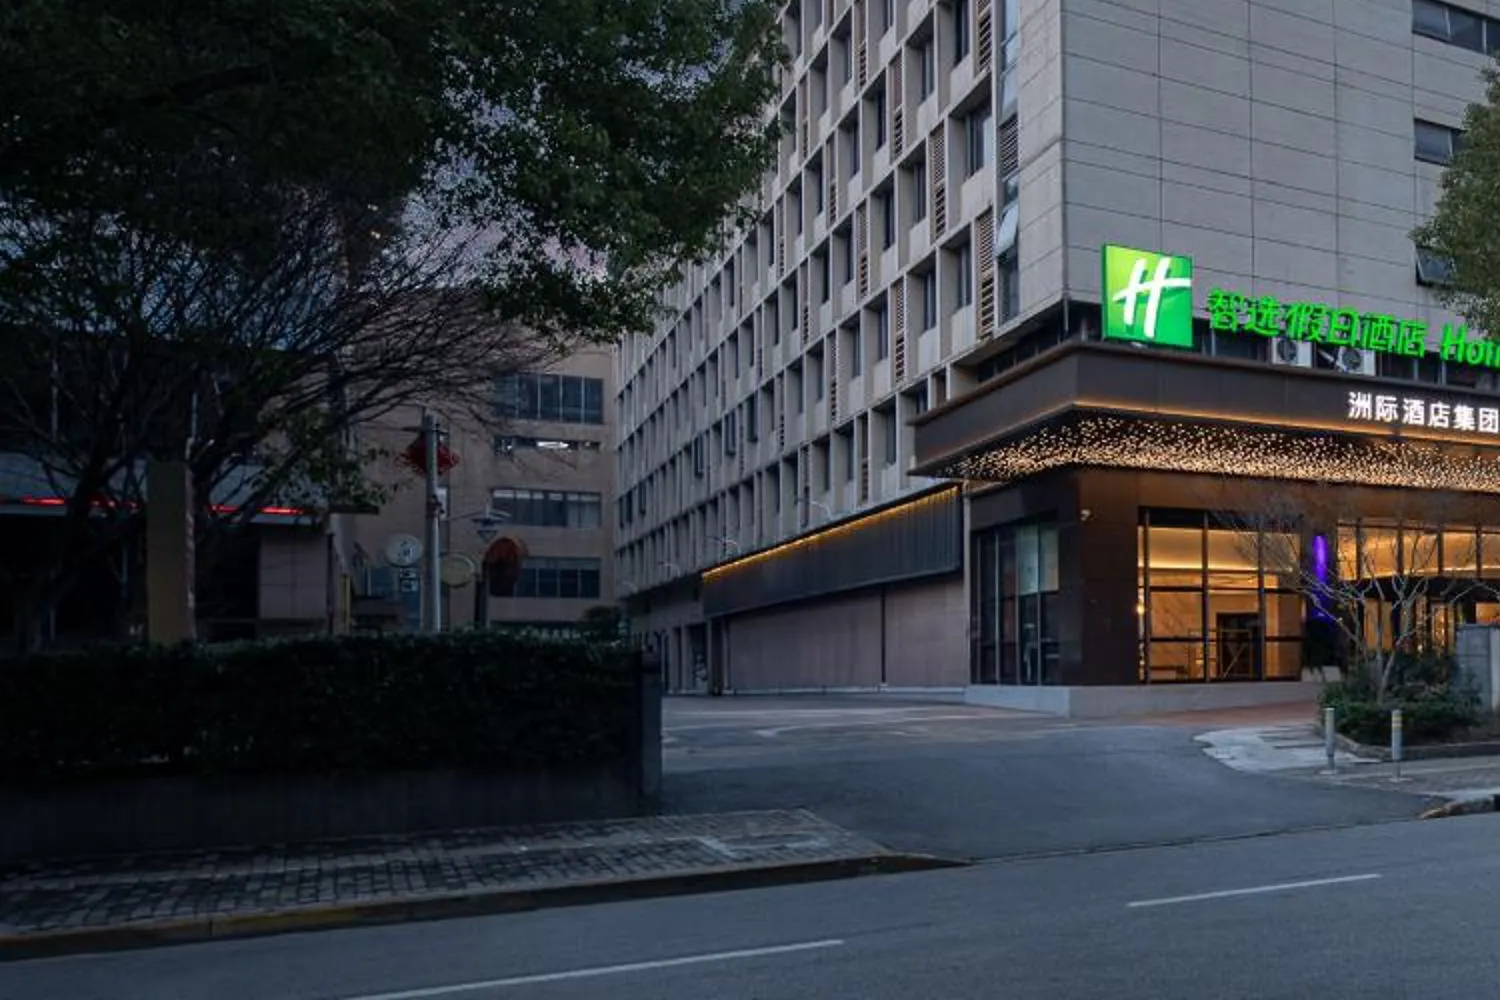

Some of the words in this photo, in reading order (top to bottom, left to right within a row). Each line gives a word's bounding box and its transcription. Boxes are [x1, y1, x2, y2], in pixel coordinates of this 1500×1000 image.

[1208, 289, 1429, 358] 智选假日酒店
